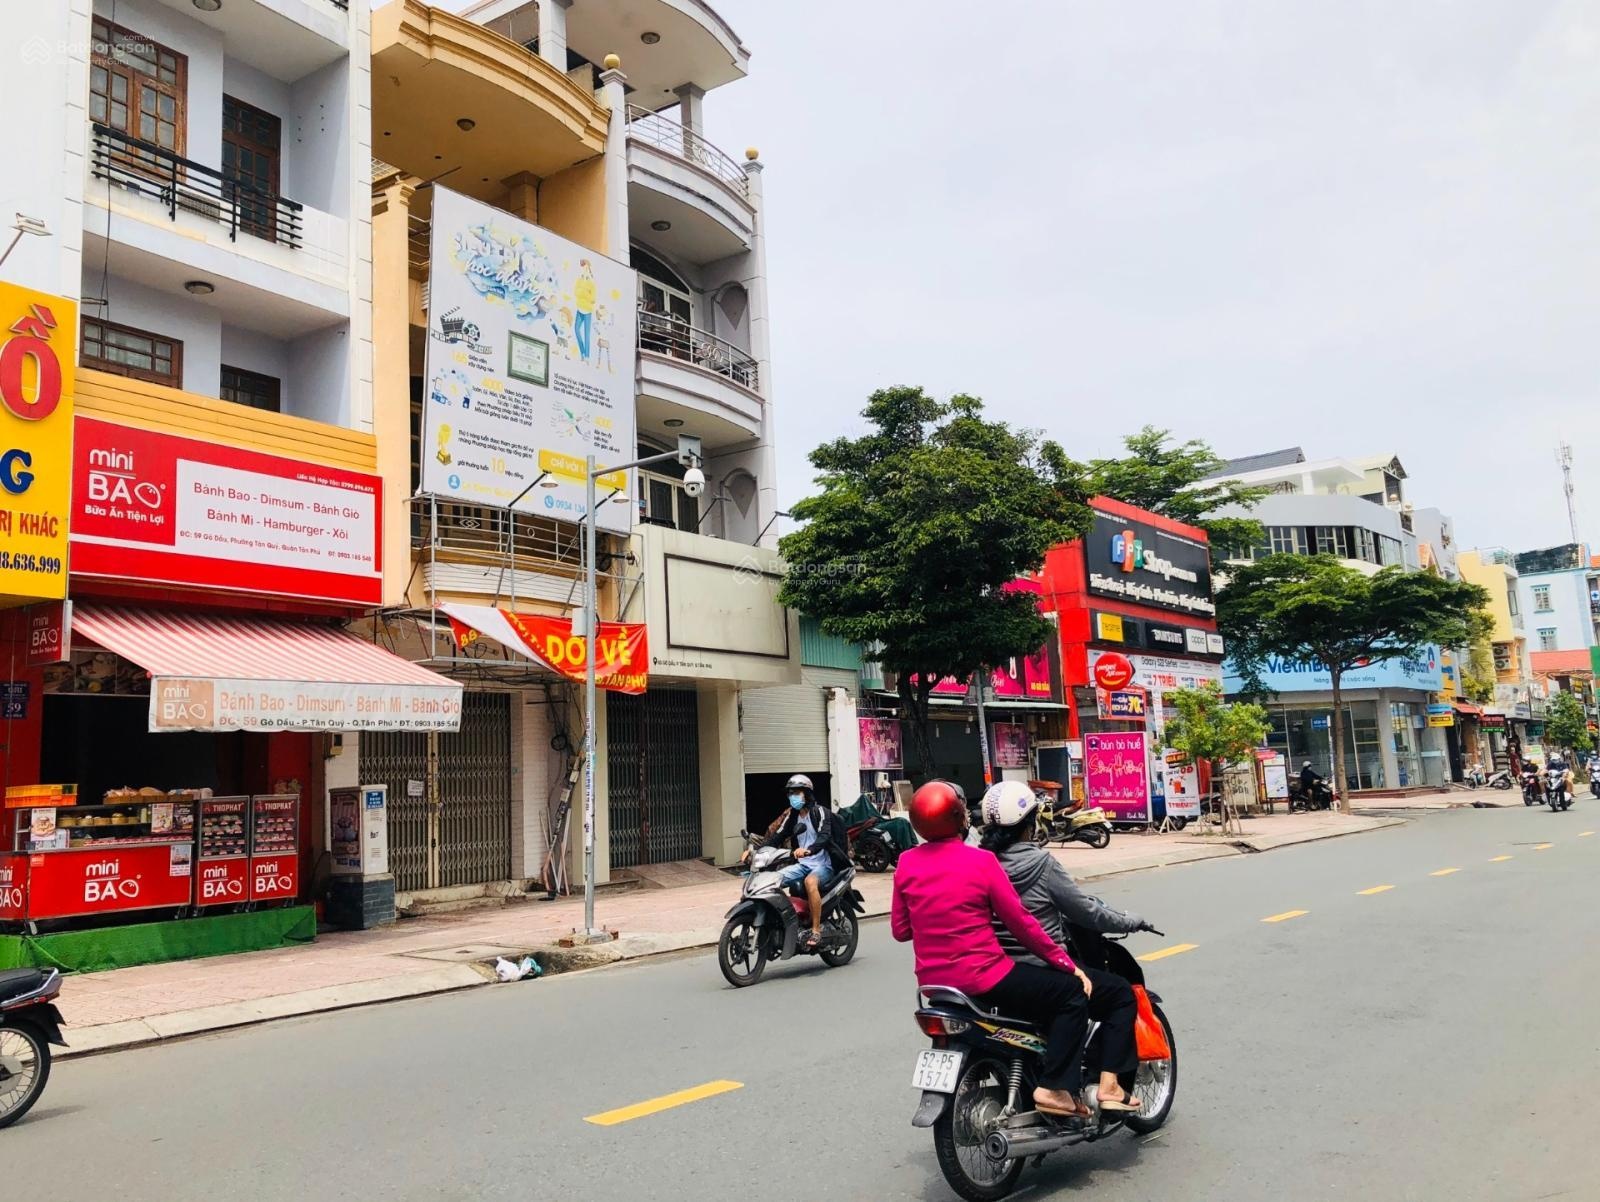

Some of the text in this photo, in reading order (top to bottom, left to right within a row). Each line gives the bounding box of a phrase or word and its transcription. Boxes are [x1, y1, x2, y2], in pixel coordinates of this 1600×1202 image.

[89, 448, 134, 471] mini
[0, 449, 35, 495] G
[194, 482, 224, 497] Bánh
[228, 488, 250, 502] Bao
[260, 494, 304, 510] Dimsum
[313, 502, 340, 516] Bánh
[20, 511, 58, 538] KHÁC
[84, 504, 164, 526] Bữa Ăn Tiện Lợi
[207, 508, 238, 523] Bánh
[263, 517, 324, 536] Hamburger
[600, 626, 631, 666] VỀ
[163, 685, 190, 698] mini
[220, 691, 254, 710] Bánh
[260, 693, 284, 710] Bao
[297, 694, 345, 712] Dimsum
[357, 696, 386, 712] Bánh
[412, 696, 439, 713] Bánh
[243, 716, 257, 726] 59
[260, 718, 274, 727] Gò
[276, 718, 294, 726] Dầu
[1101, 737, 1141, 750] bún bò huế
[86, 859, 119, 876] mini
[204, 864, 227, 878] mini
[256, 861, 278, 874] mini
[922, 1052, 954, 1070] 52-P5
[920, 1070, 948, 1088] 1574
